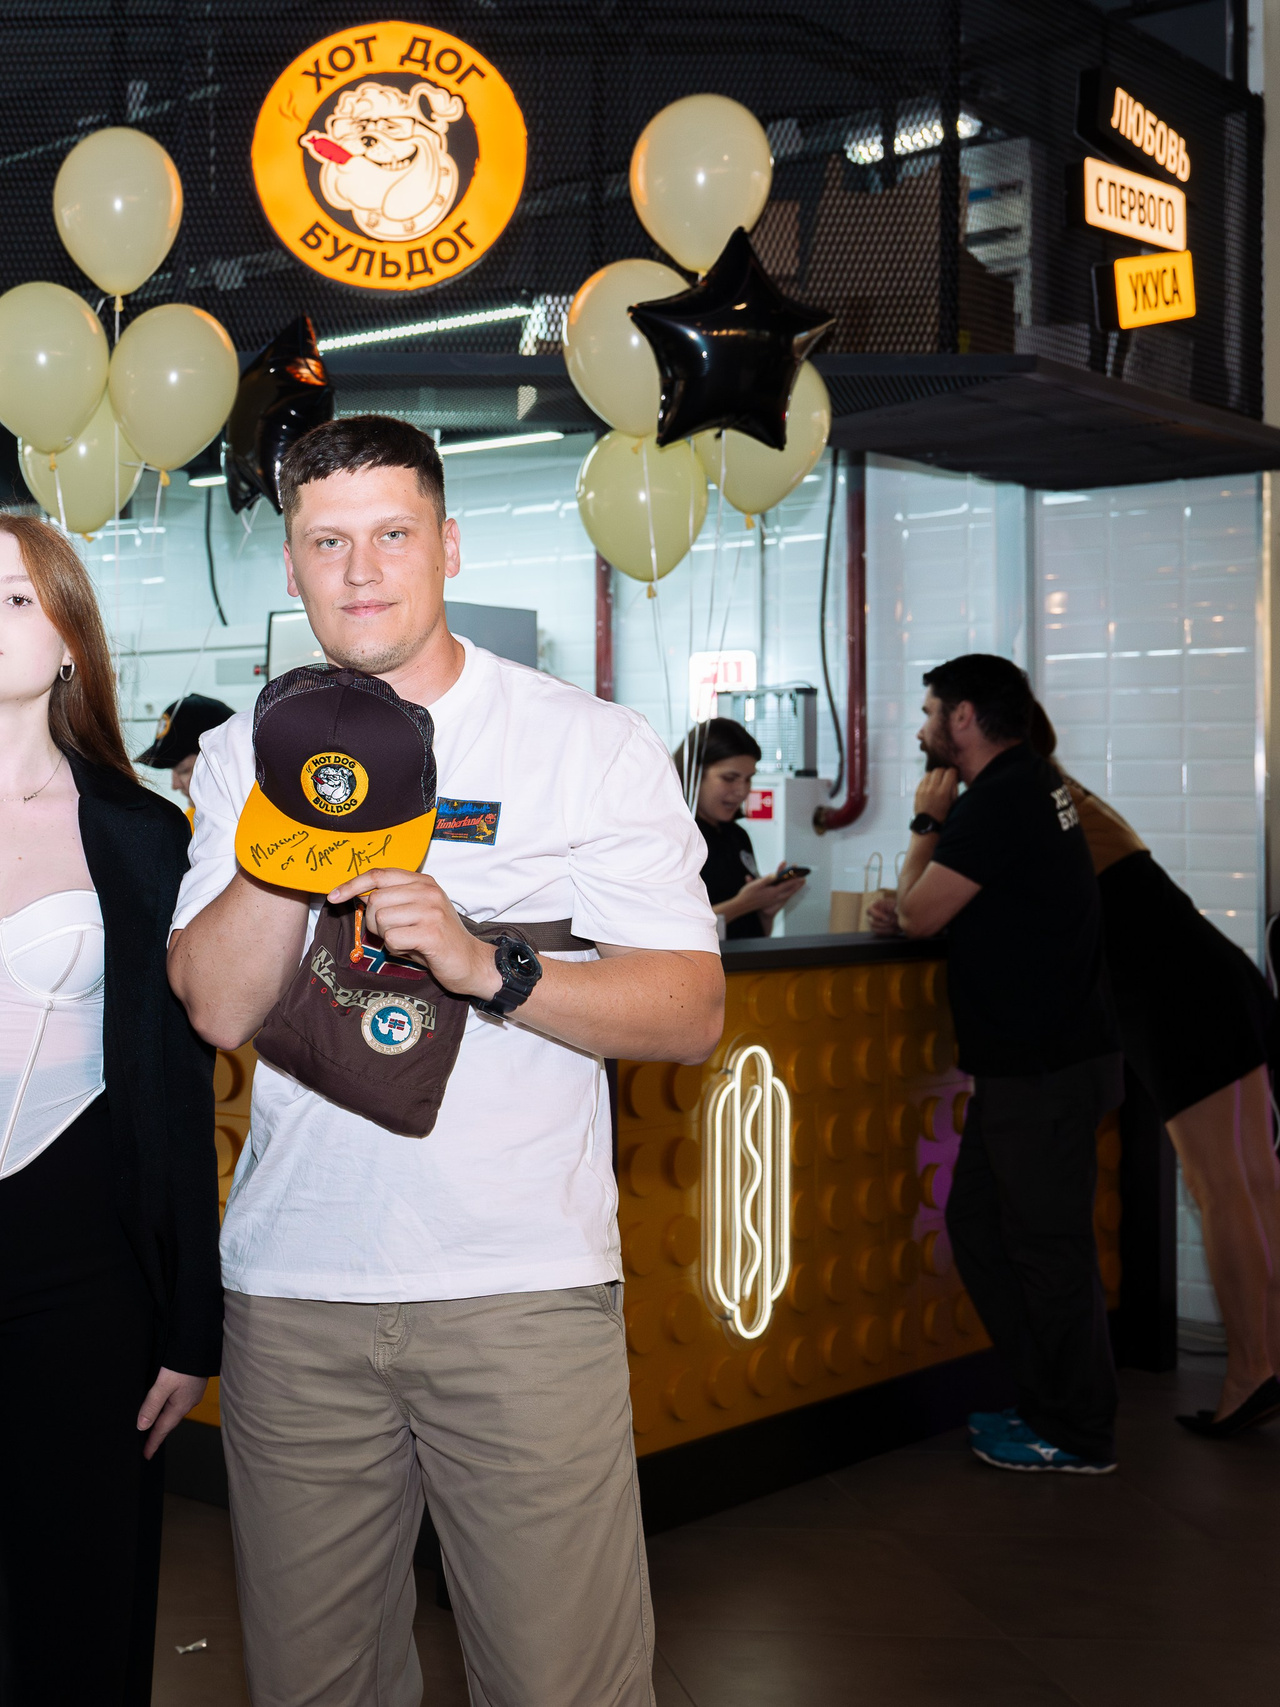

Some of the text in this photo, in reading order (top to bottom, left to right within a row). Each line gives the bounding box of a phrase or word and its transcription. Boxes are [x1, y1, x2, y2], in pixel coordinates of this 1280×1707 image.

[300, 34, 487, 94] ХОТ ДОГ
[1110, 86, 1191, 183] ЛЮБОВЬ
[1094, 176, 1176, 234] С ПЕРВОГО
[298, 220, 476, 281] БУЛЬДОГ
[1128, 267, 1182, 313] УКУСА
[311, 755, 357, 769] HOT DOG
[311, 796, 359, 814] BULLDOG
[435, 813, 485, 830] Timberland
